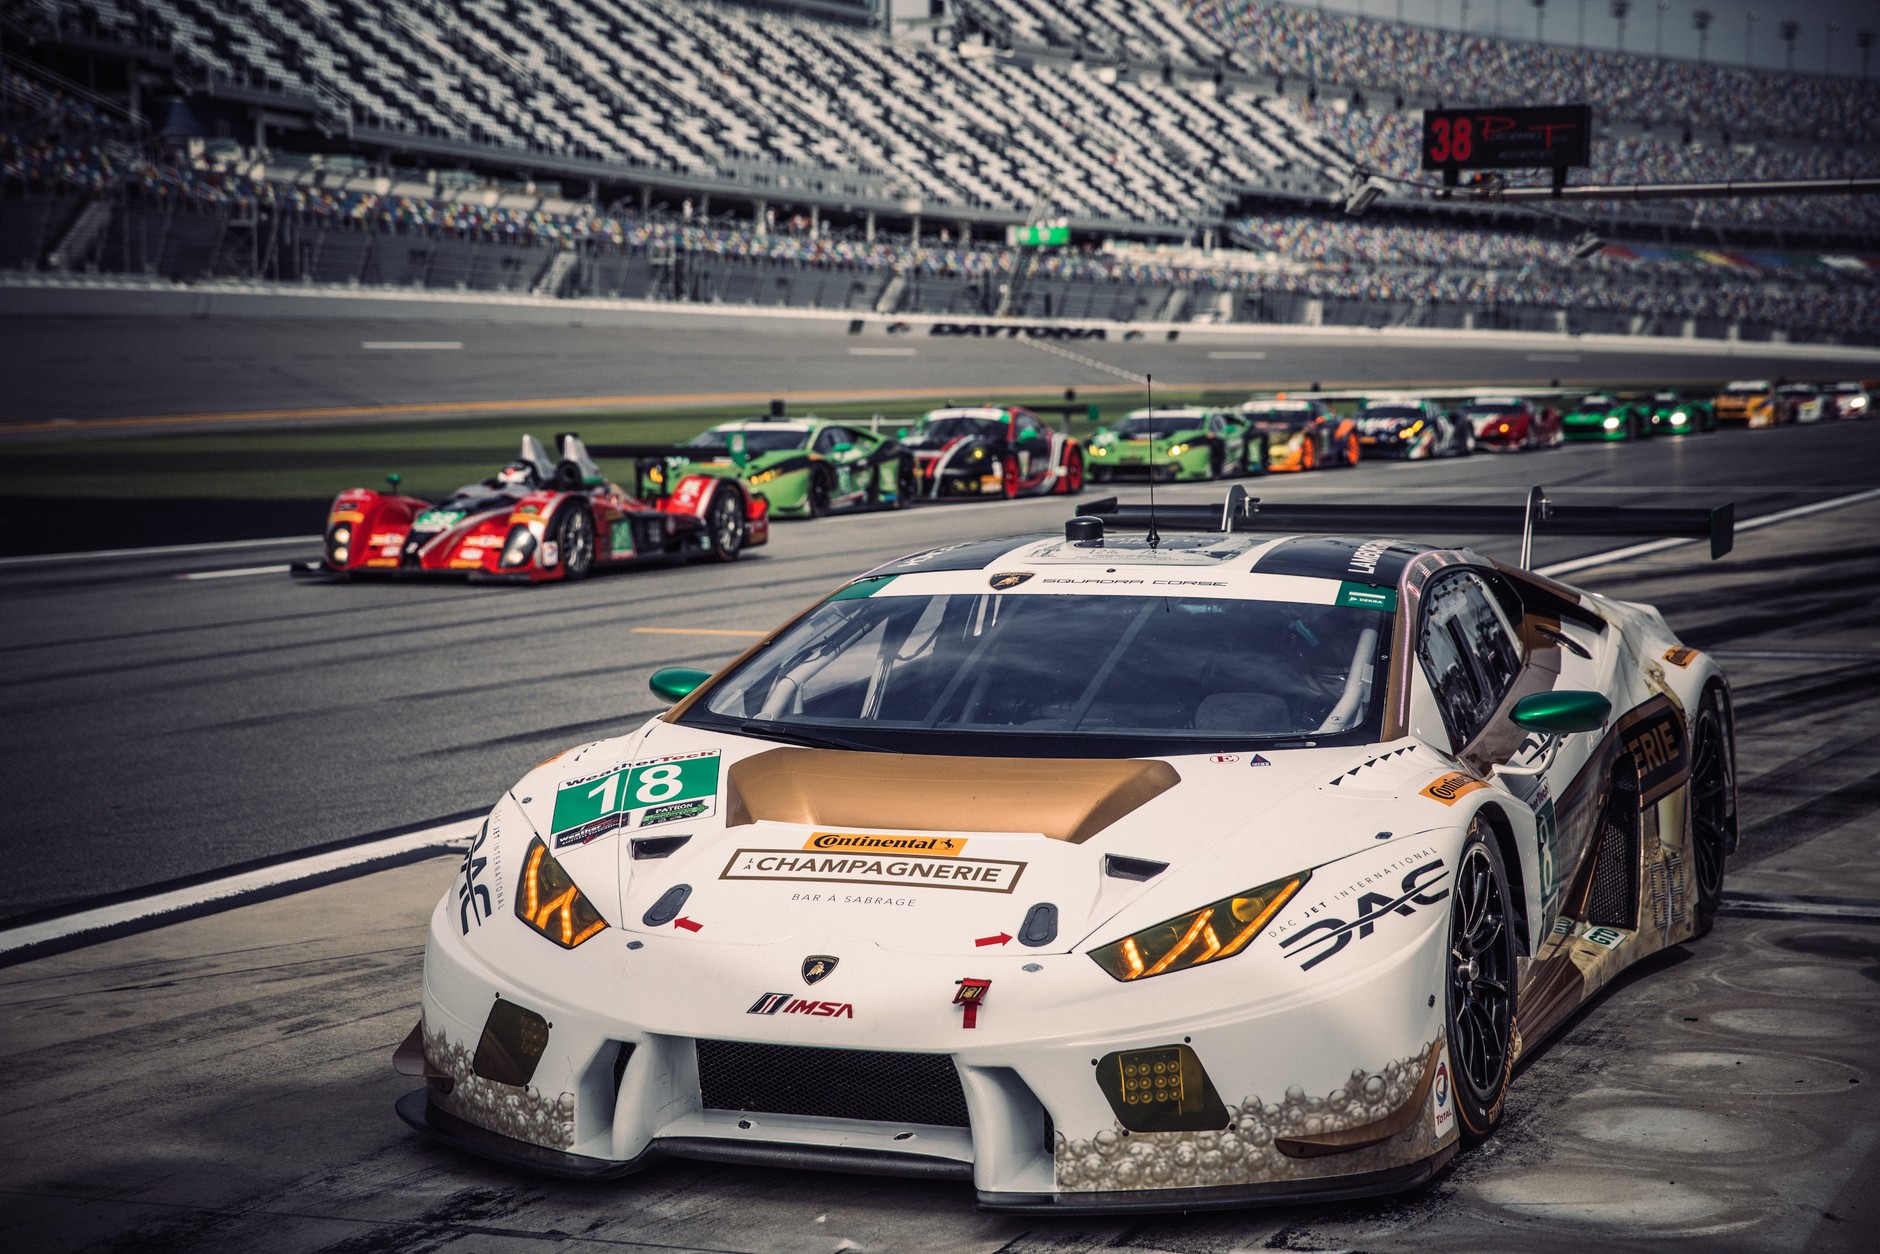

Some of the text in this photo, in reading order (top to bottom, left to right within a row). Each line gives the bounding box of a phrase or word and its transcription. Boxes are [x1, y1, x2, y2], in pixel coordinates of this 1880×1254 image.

[1430, 118, 1472, 161] 38
[929, 323, 1106, 341] DAYTONA
[1042, 578, 1229, 588] SQUADRA CORSE
[566, 750, 717, 787] WeatherTech
[587, 764, 683, 815] 18
[813, 834, 936, 850] Continental
[756, 857, 1002, 883] CHAMPAGNERIE
[792, 893, 917, 907] BAR À SABRAGE
[1268, 847, 1438, 939] DAC JET INTERNATIONAL
[1278, 858, 1450, 972] DAC
[1588, 927, 1620, 945] GTD
[782, 999, 853, 1018] IMSA
[1435, 1110, 1452, 1126] TOTAL
